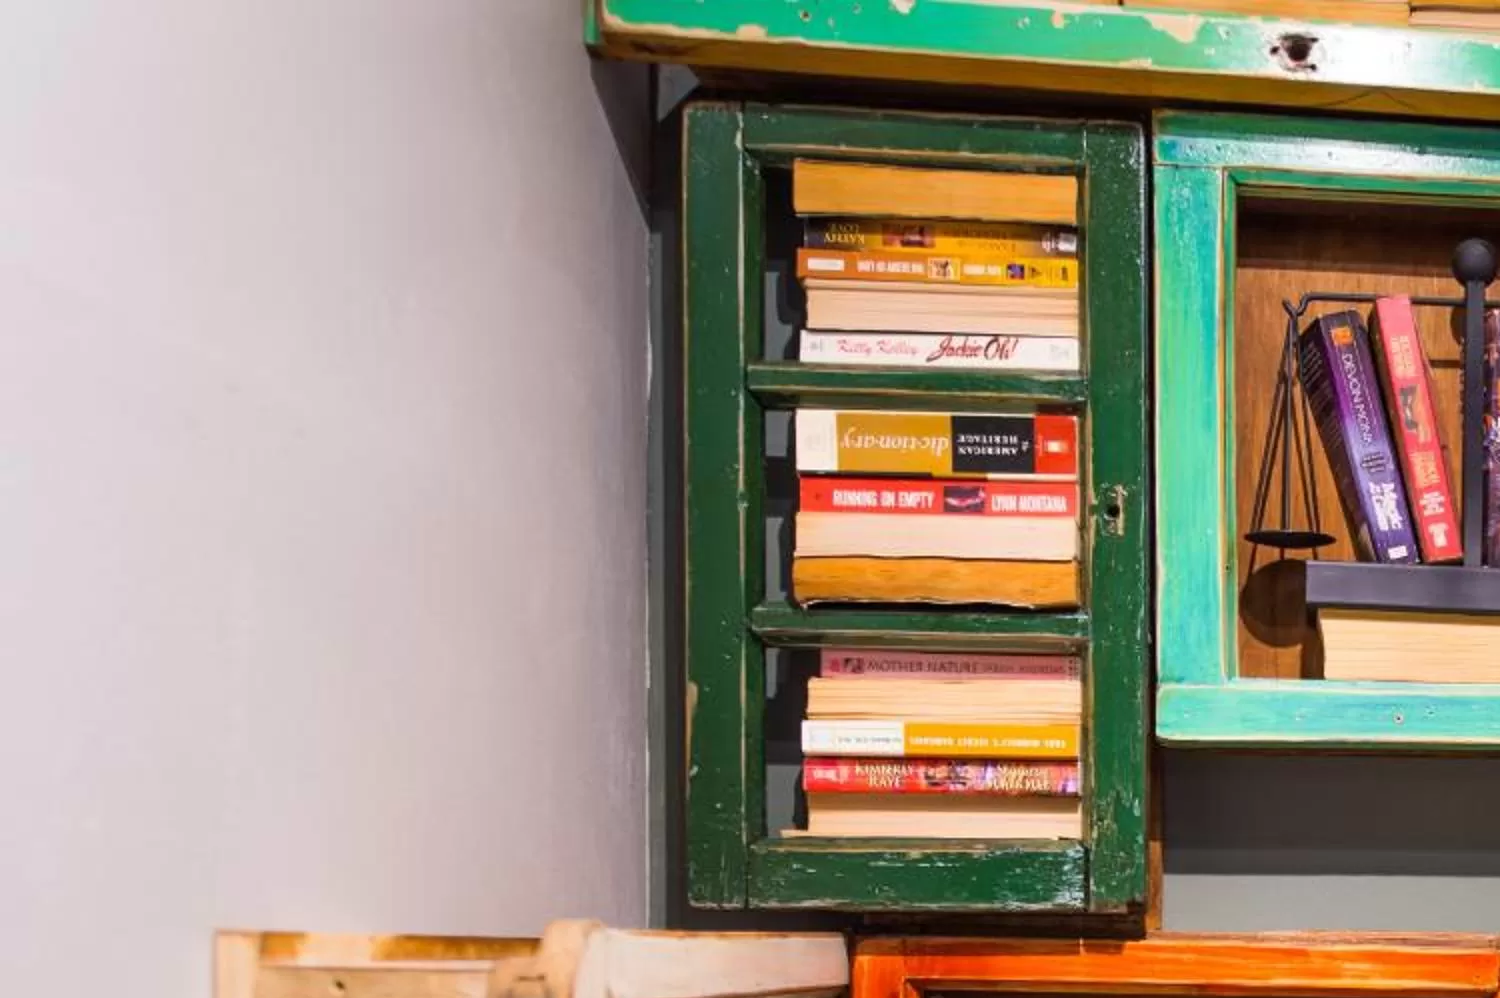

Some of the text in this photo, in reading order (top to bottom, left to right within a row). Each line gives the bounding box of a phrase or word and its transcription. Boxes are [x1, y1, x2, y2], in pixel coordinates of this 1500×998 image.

[837, 338, 871, 356] Kitty
[926, 335, 1019, 362] Jackie Oh!
[1341, 352, 1361, 404] DEVON
[957, 434, 1018, 443] HERITAGE
[958, 446, 1018, 455] AMERICAN
[832, 489, 935, 508] RUNNING ON EMPTY
[867, 658, 979, 674] MOTHER NATURE
